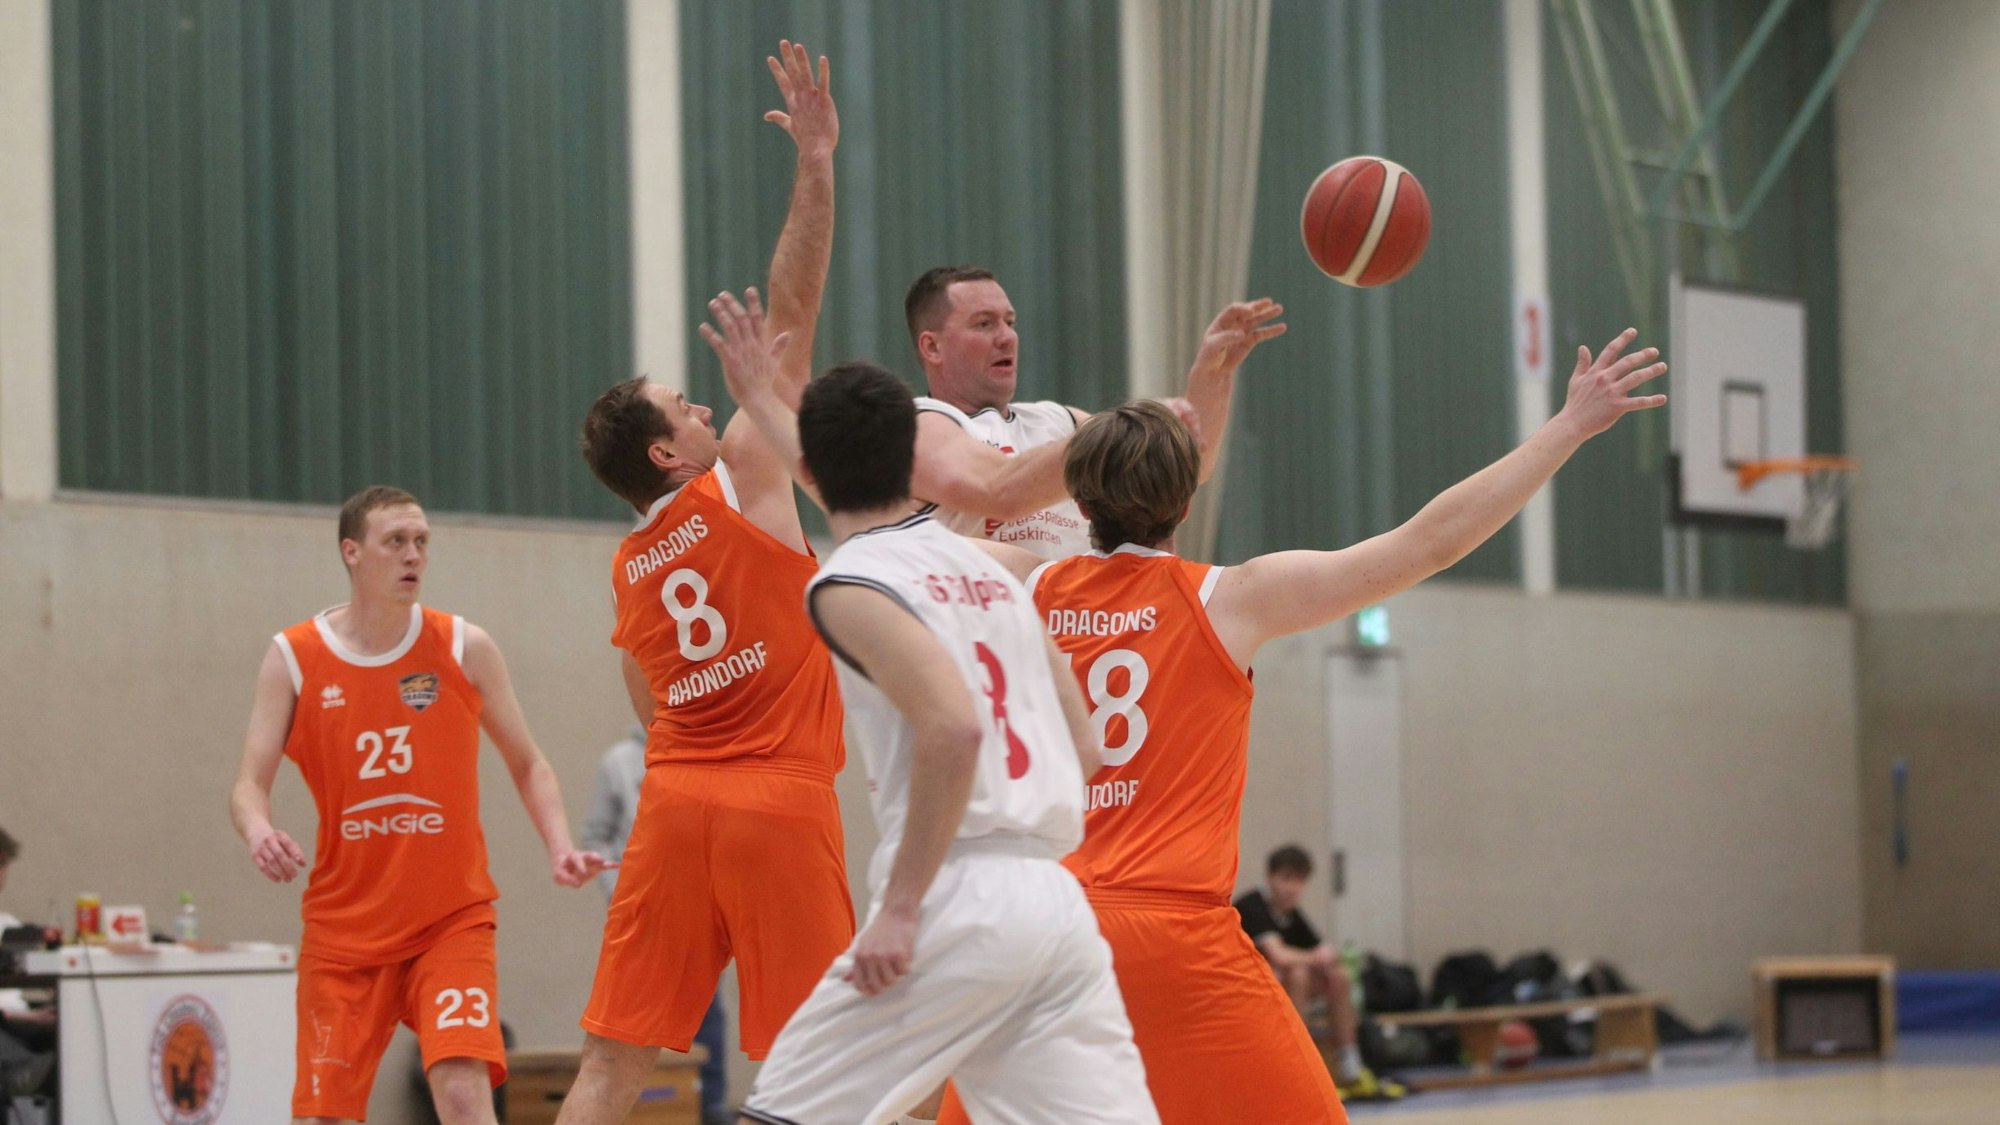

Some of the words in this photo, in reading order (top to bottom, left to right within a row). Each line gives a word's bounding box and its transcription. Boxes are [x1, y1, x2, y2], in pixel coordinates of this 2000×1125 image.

[625, 513, 709, 586] DRAGONS
[661, 568, 728, 662] 8
[1048, 606, 1157, 636] DRAGONS
[1060, 648, 1149, 767] 8
[355, 725, 414, 780] 23
[435, 986, 490, 1031] 23
